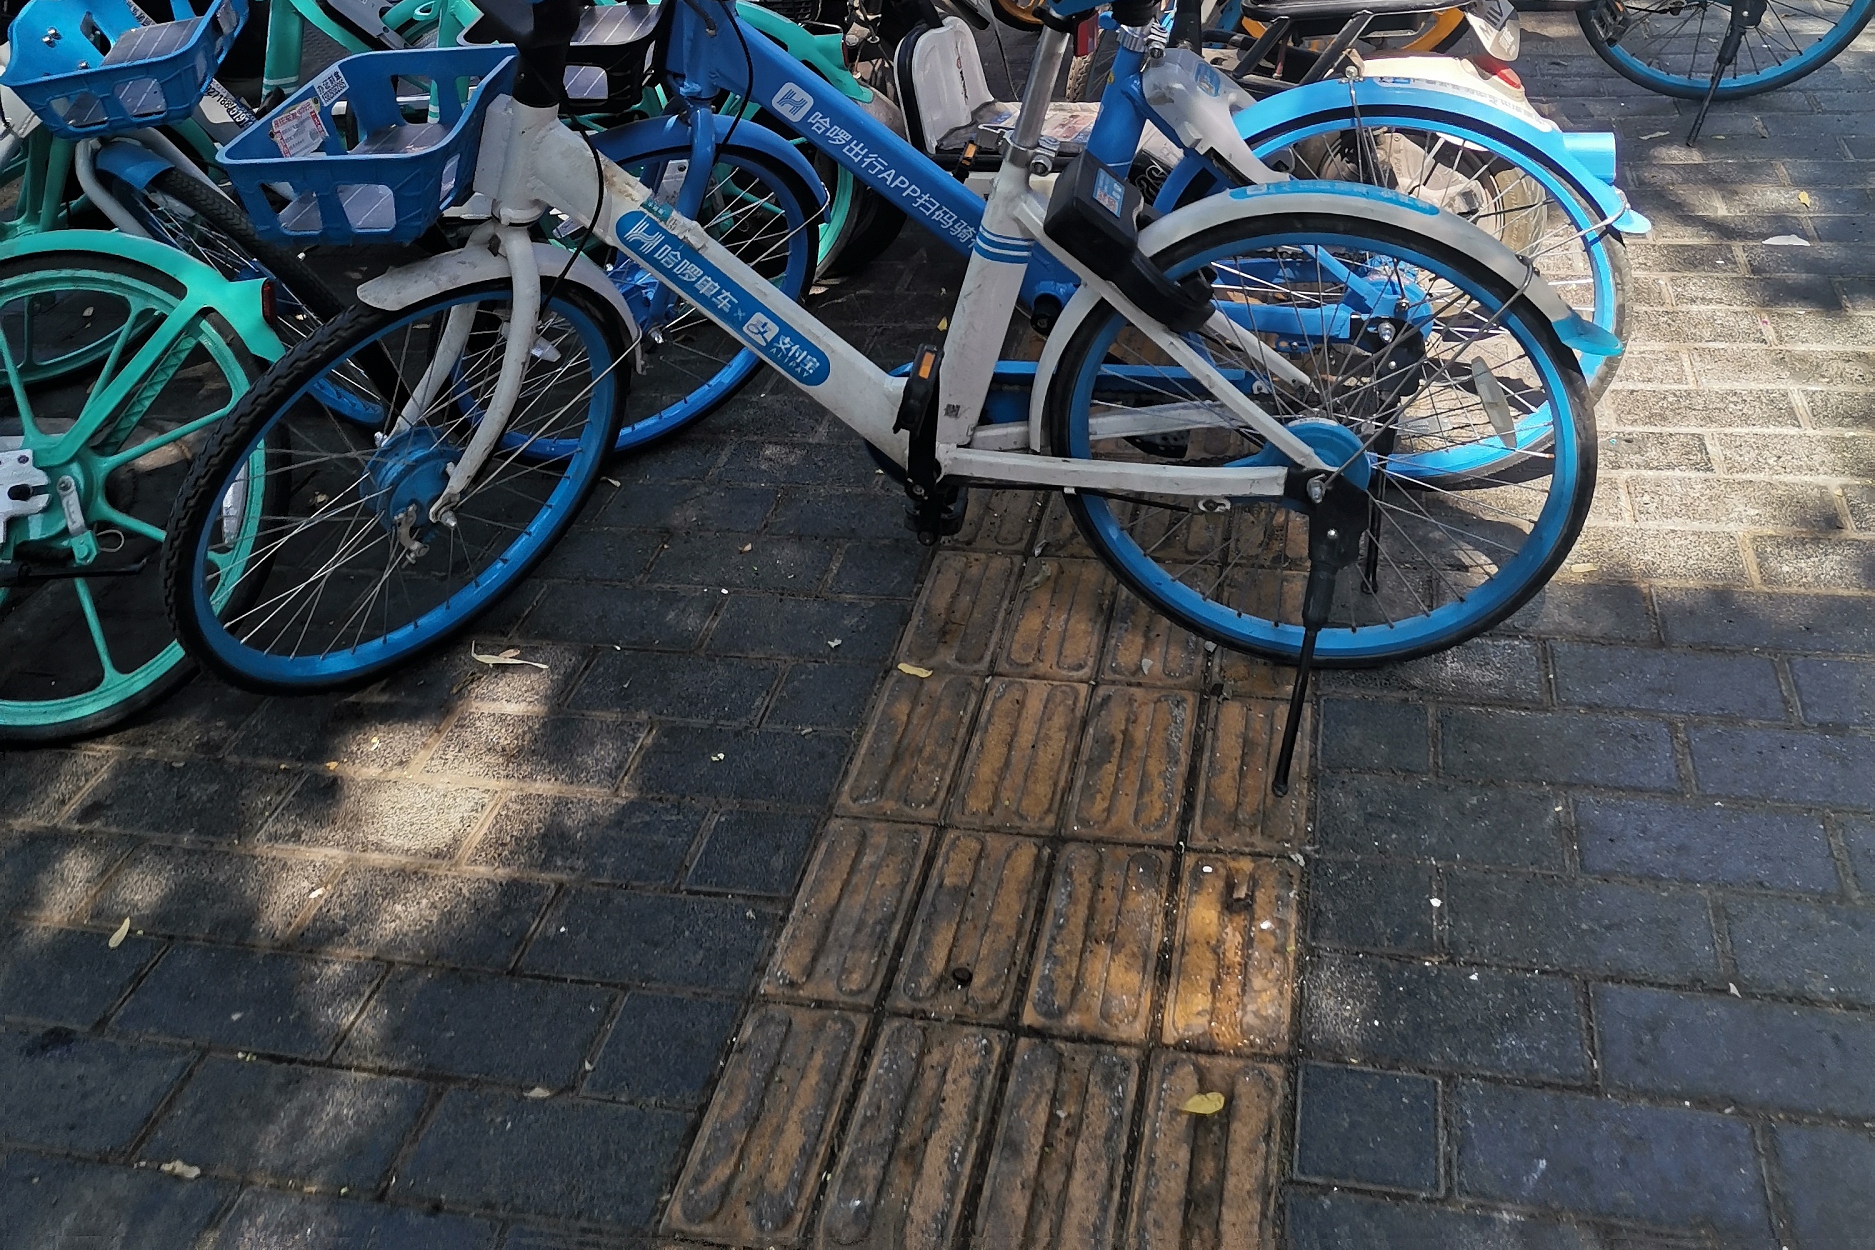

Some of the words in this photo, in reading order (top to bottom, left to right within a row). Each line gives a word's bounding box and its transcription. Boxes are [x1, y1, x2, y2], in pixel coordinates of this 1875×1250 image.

[769, 347, 810, 379] ALIPAY
[774, 334, 821, 375] 支付宝
